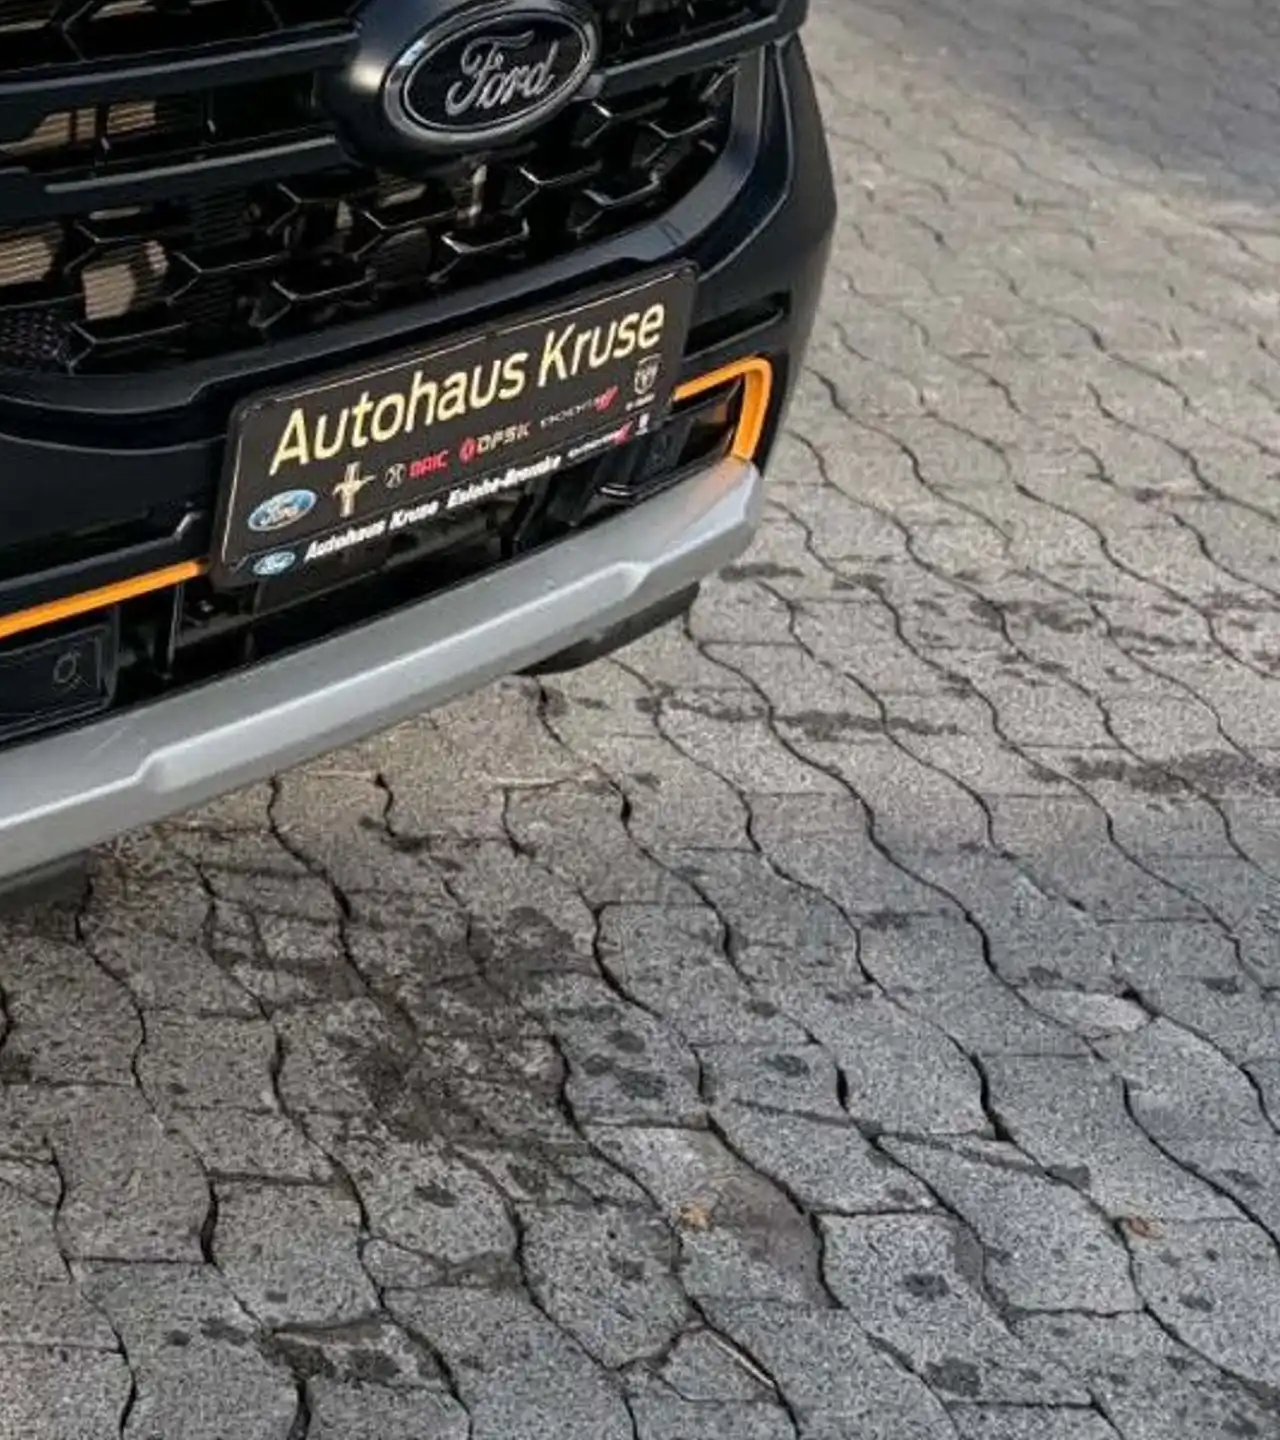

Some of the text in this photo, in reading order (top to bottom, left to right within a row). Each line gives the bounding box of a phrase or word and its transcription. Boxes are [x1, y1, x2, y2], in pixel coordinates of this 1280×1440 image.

[445, 28, 559, 116] Ford
[269, 347, 529, 476] Autohaus
[537, 302, 666, 388] Kruse
